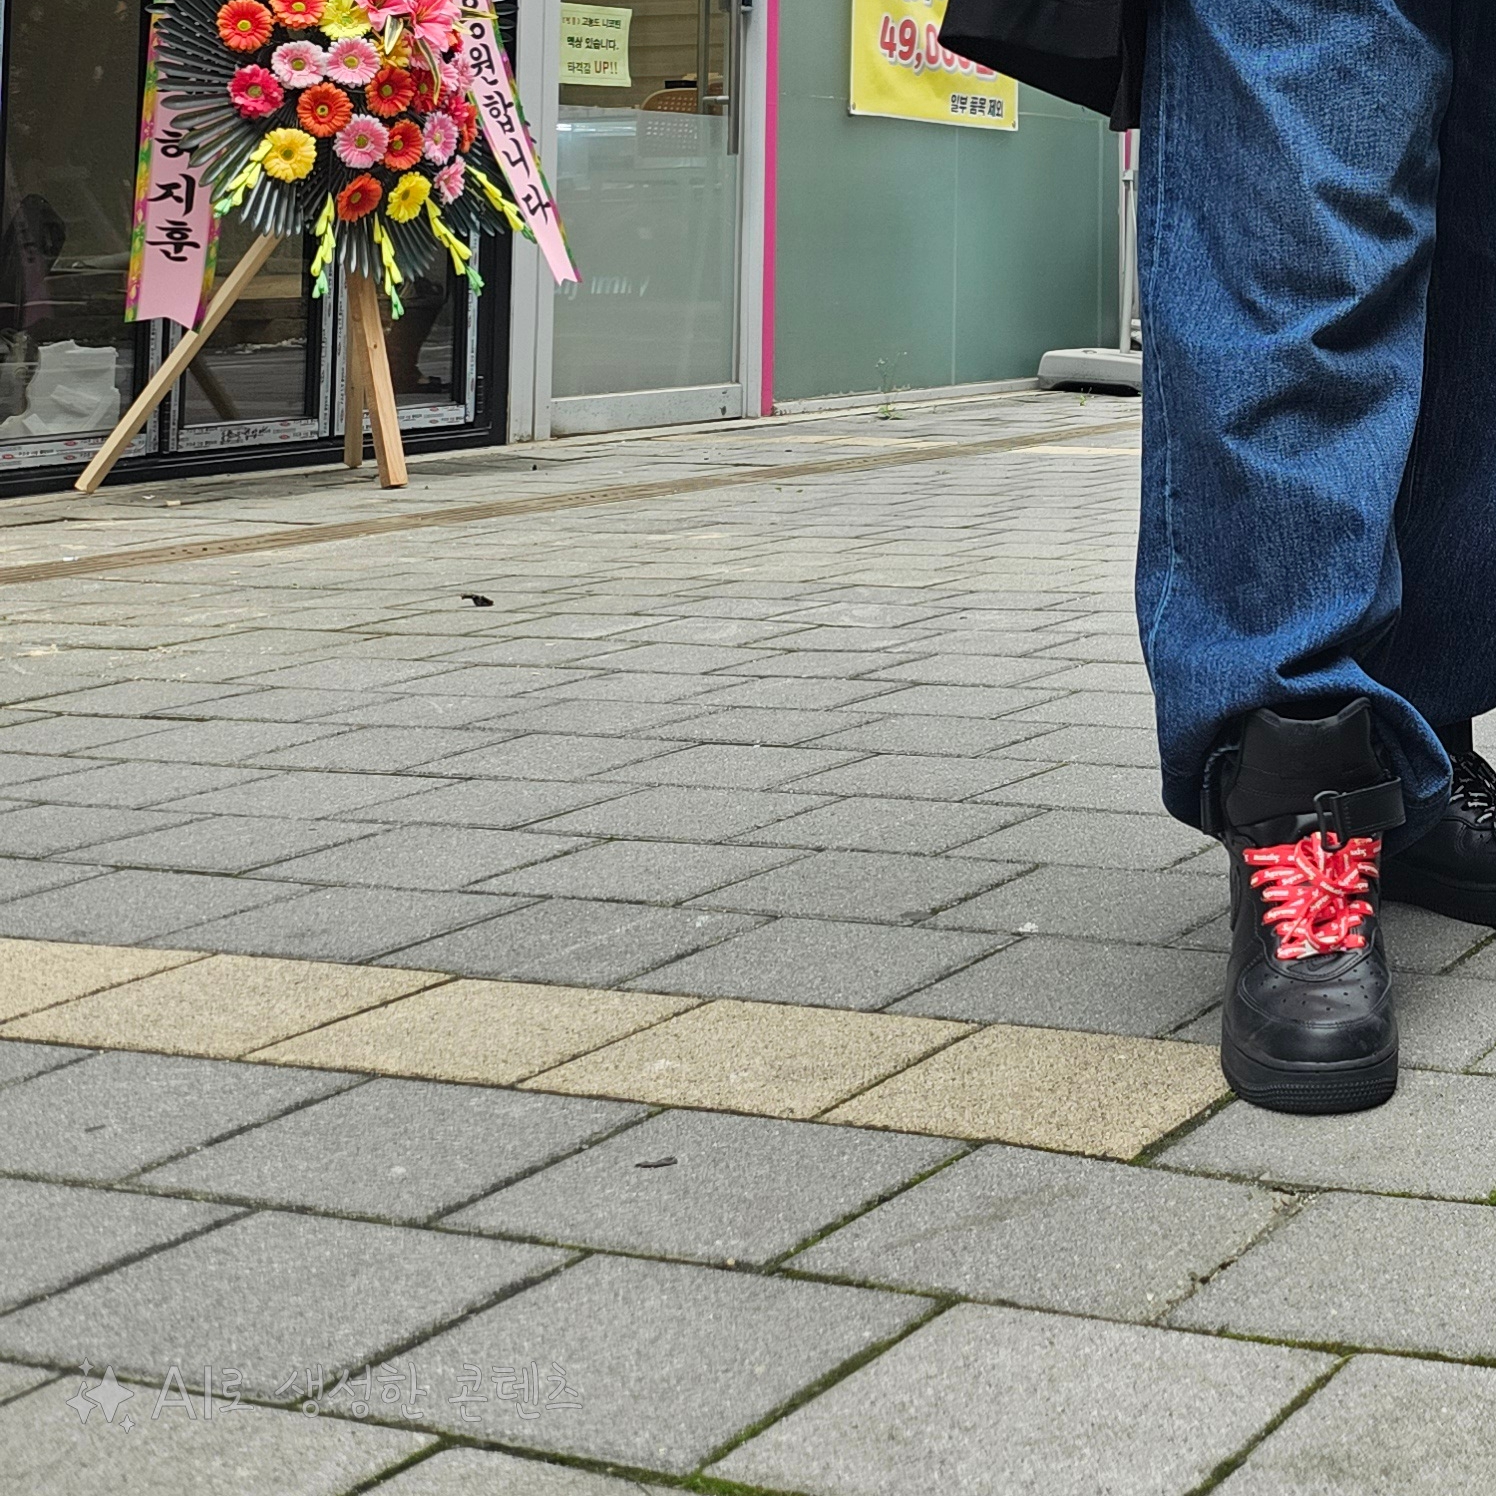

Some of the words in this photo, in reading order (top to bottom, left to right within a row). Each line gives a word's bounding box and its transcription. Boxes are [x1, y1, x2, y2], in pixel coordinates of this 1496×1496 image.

[594, 60, 618, 75] UP!!
[950, 94, 968, 114] 일부
[970, 96, 987, 117] 품목
[988, 99, 1004, 119] 제외
